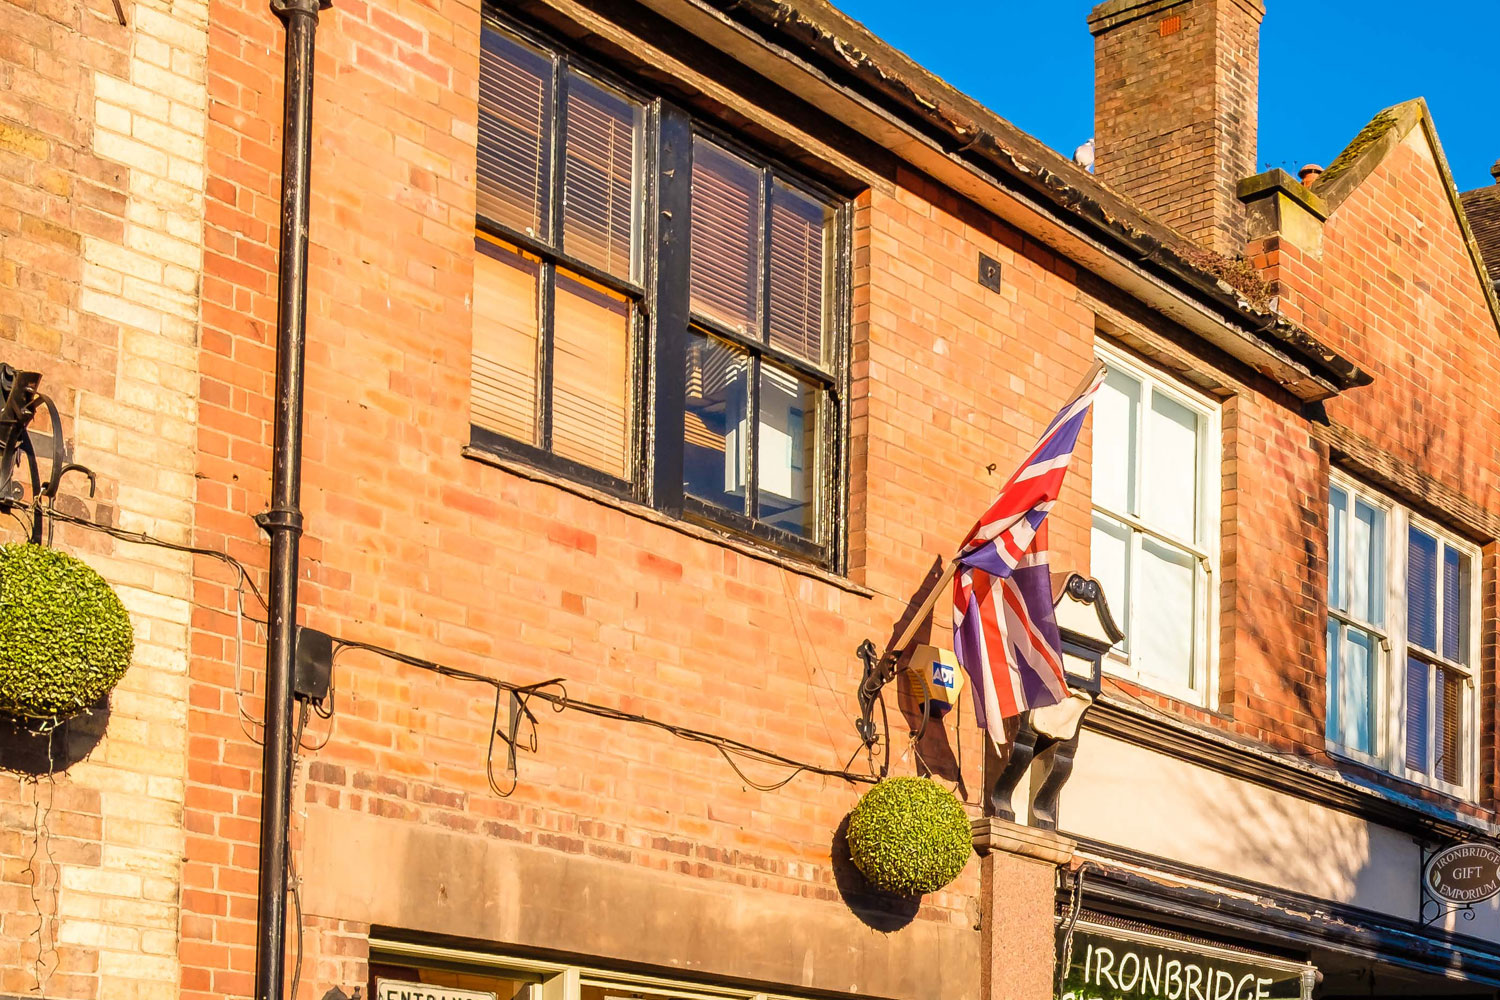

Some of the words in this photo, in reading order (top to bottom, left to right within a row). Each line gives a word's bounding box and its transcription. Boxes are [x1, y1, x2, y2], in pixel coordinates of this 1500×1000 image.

[933, 667, 954, 685] ADT
[1435, 847, 1500, 869] IRONBRIDGE
[1452, 866, 1483, 880] GIFT
[1439, 879, 1497, 900] EMPORIUM
